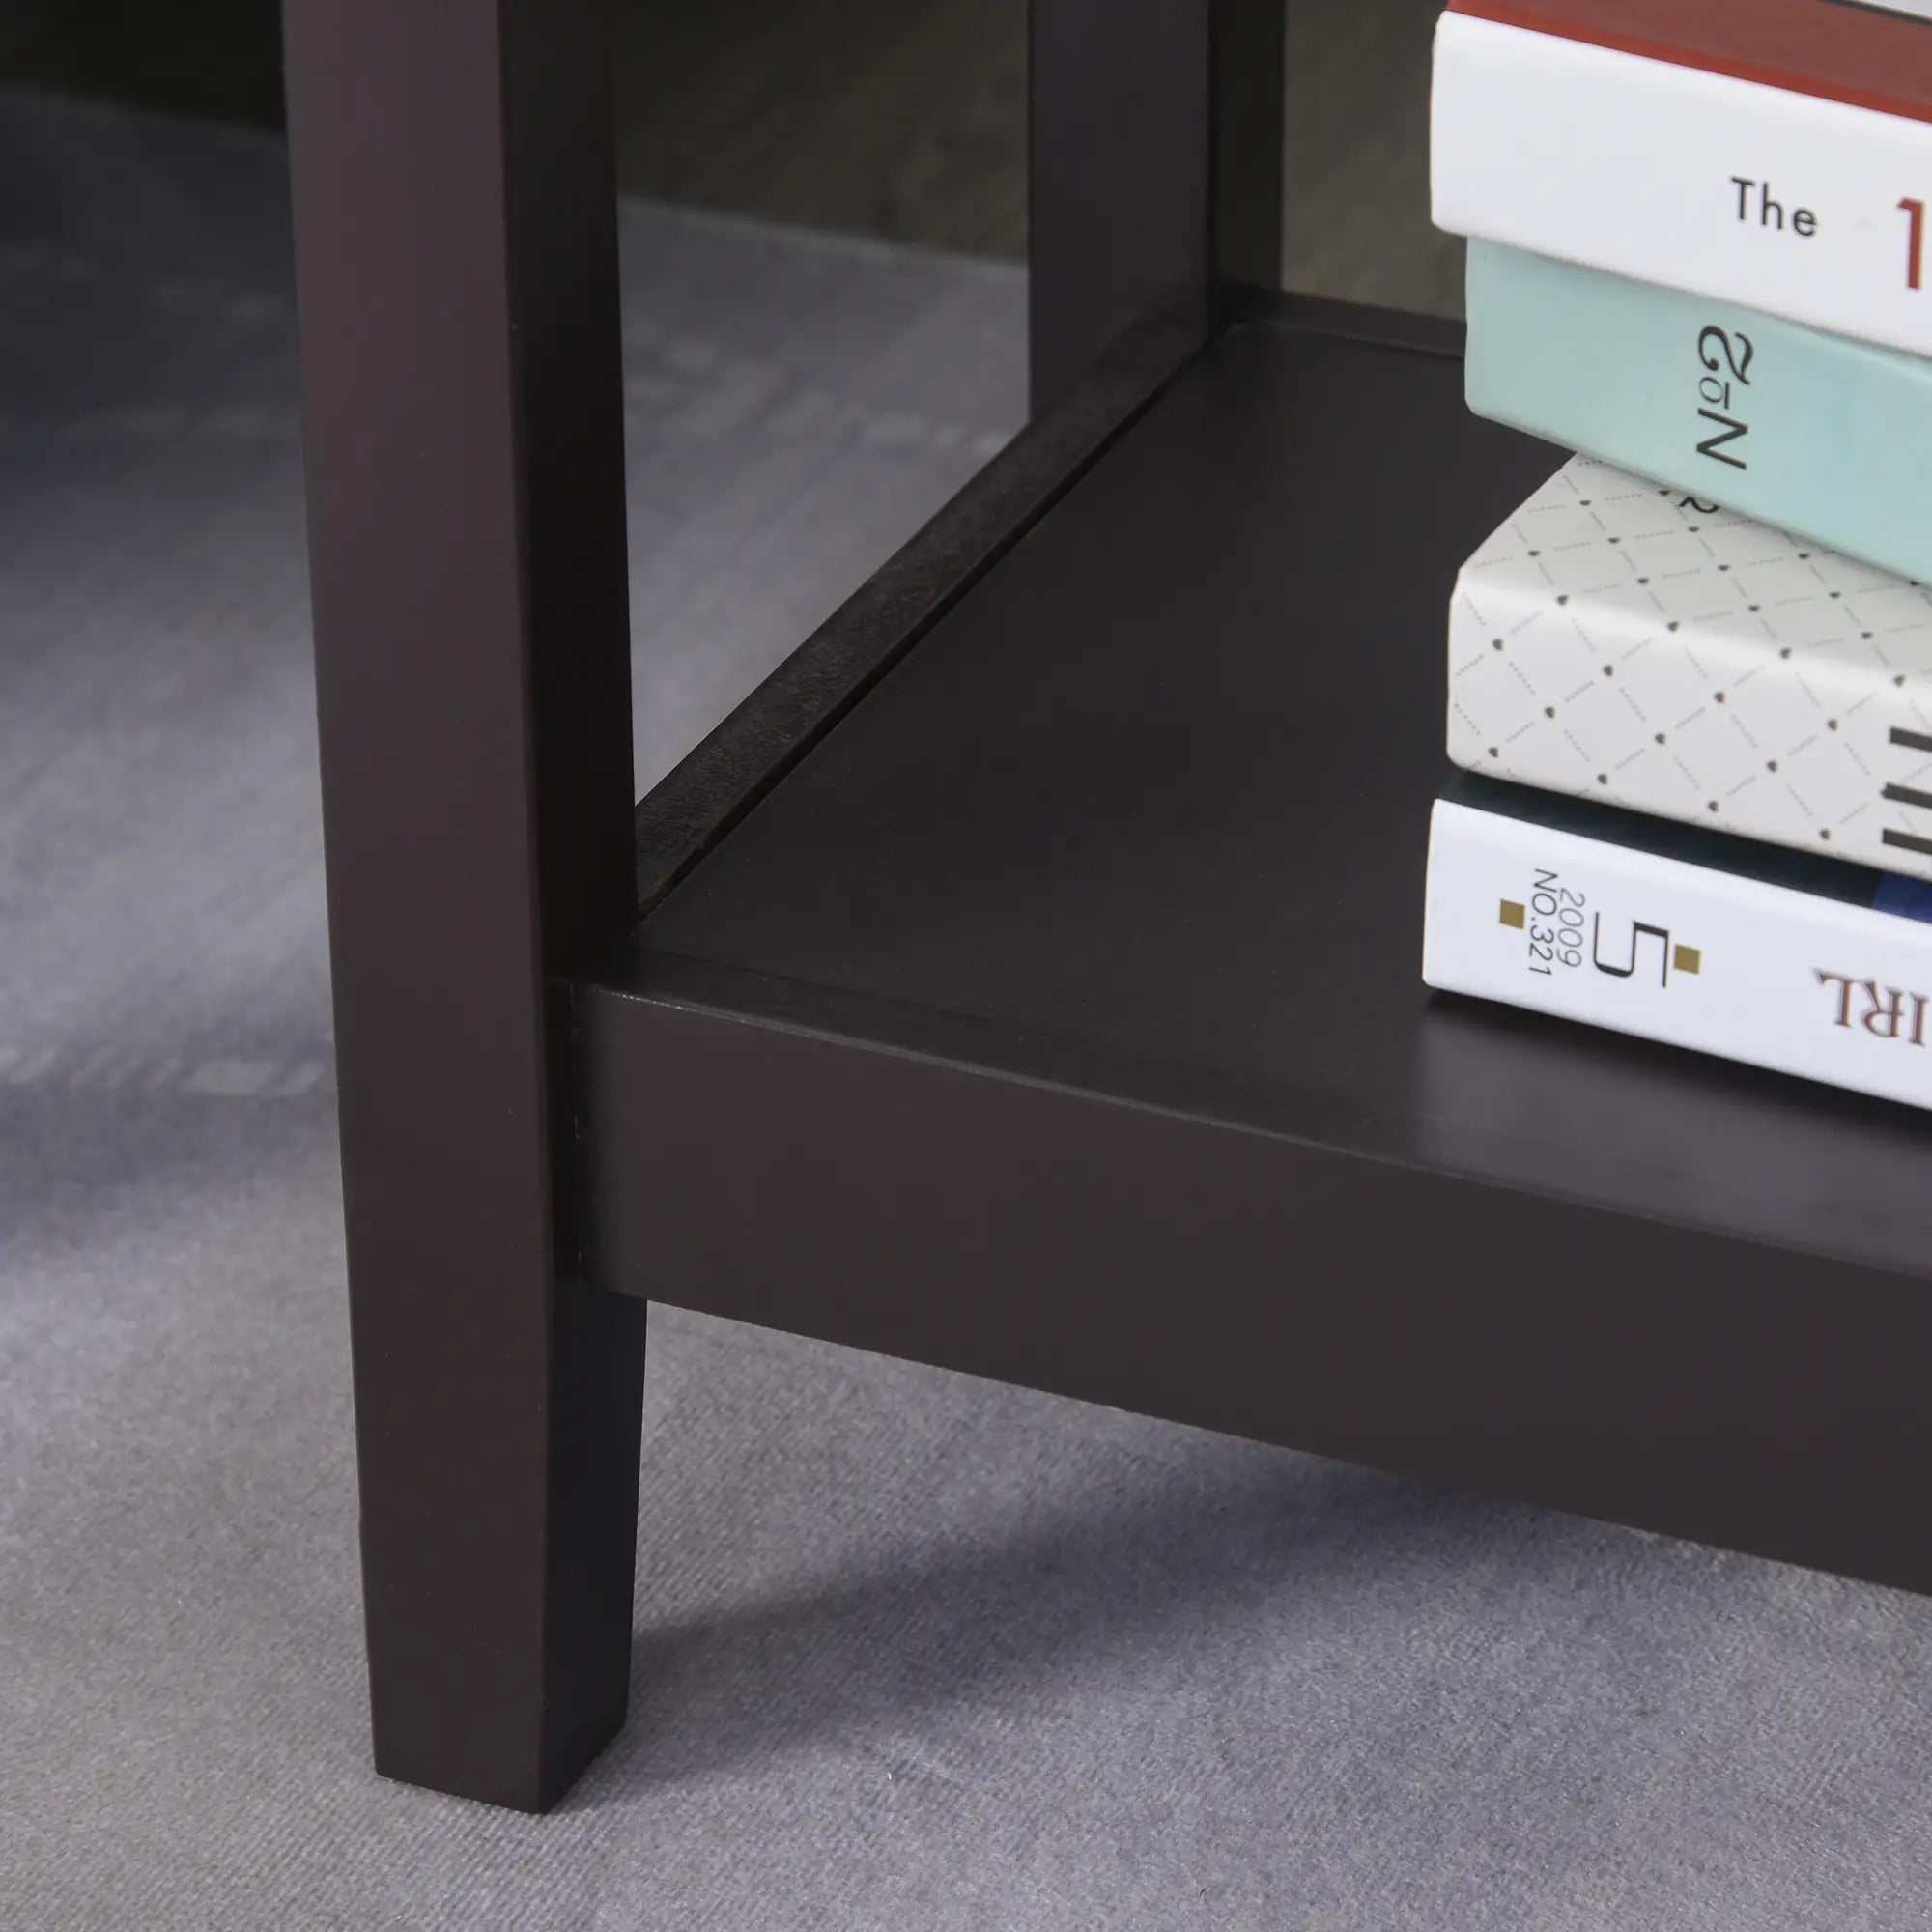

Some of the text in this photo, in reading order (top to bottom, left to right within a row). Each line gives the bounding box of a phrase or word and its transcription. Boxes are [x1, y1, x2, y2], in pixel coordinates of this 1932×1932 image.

[1730, 176, 1817, 238] The
[1528, 867, 1559, 977] NO.321
[1556, 887, 1586, 968] 2009
[1592, 911, 1670, 989] 5
